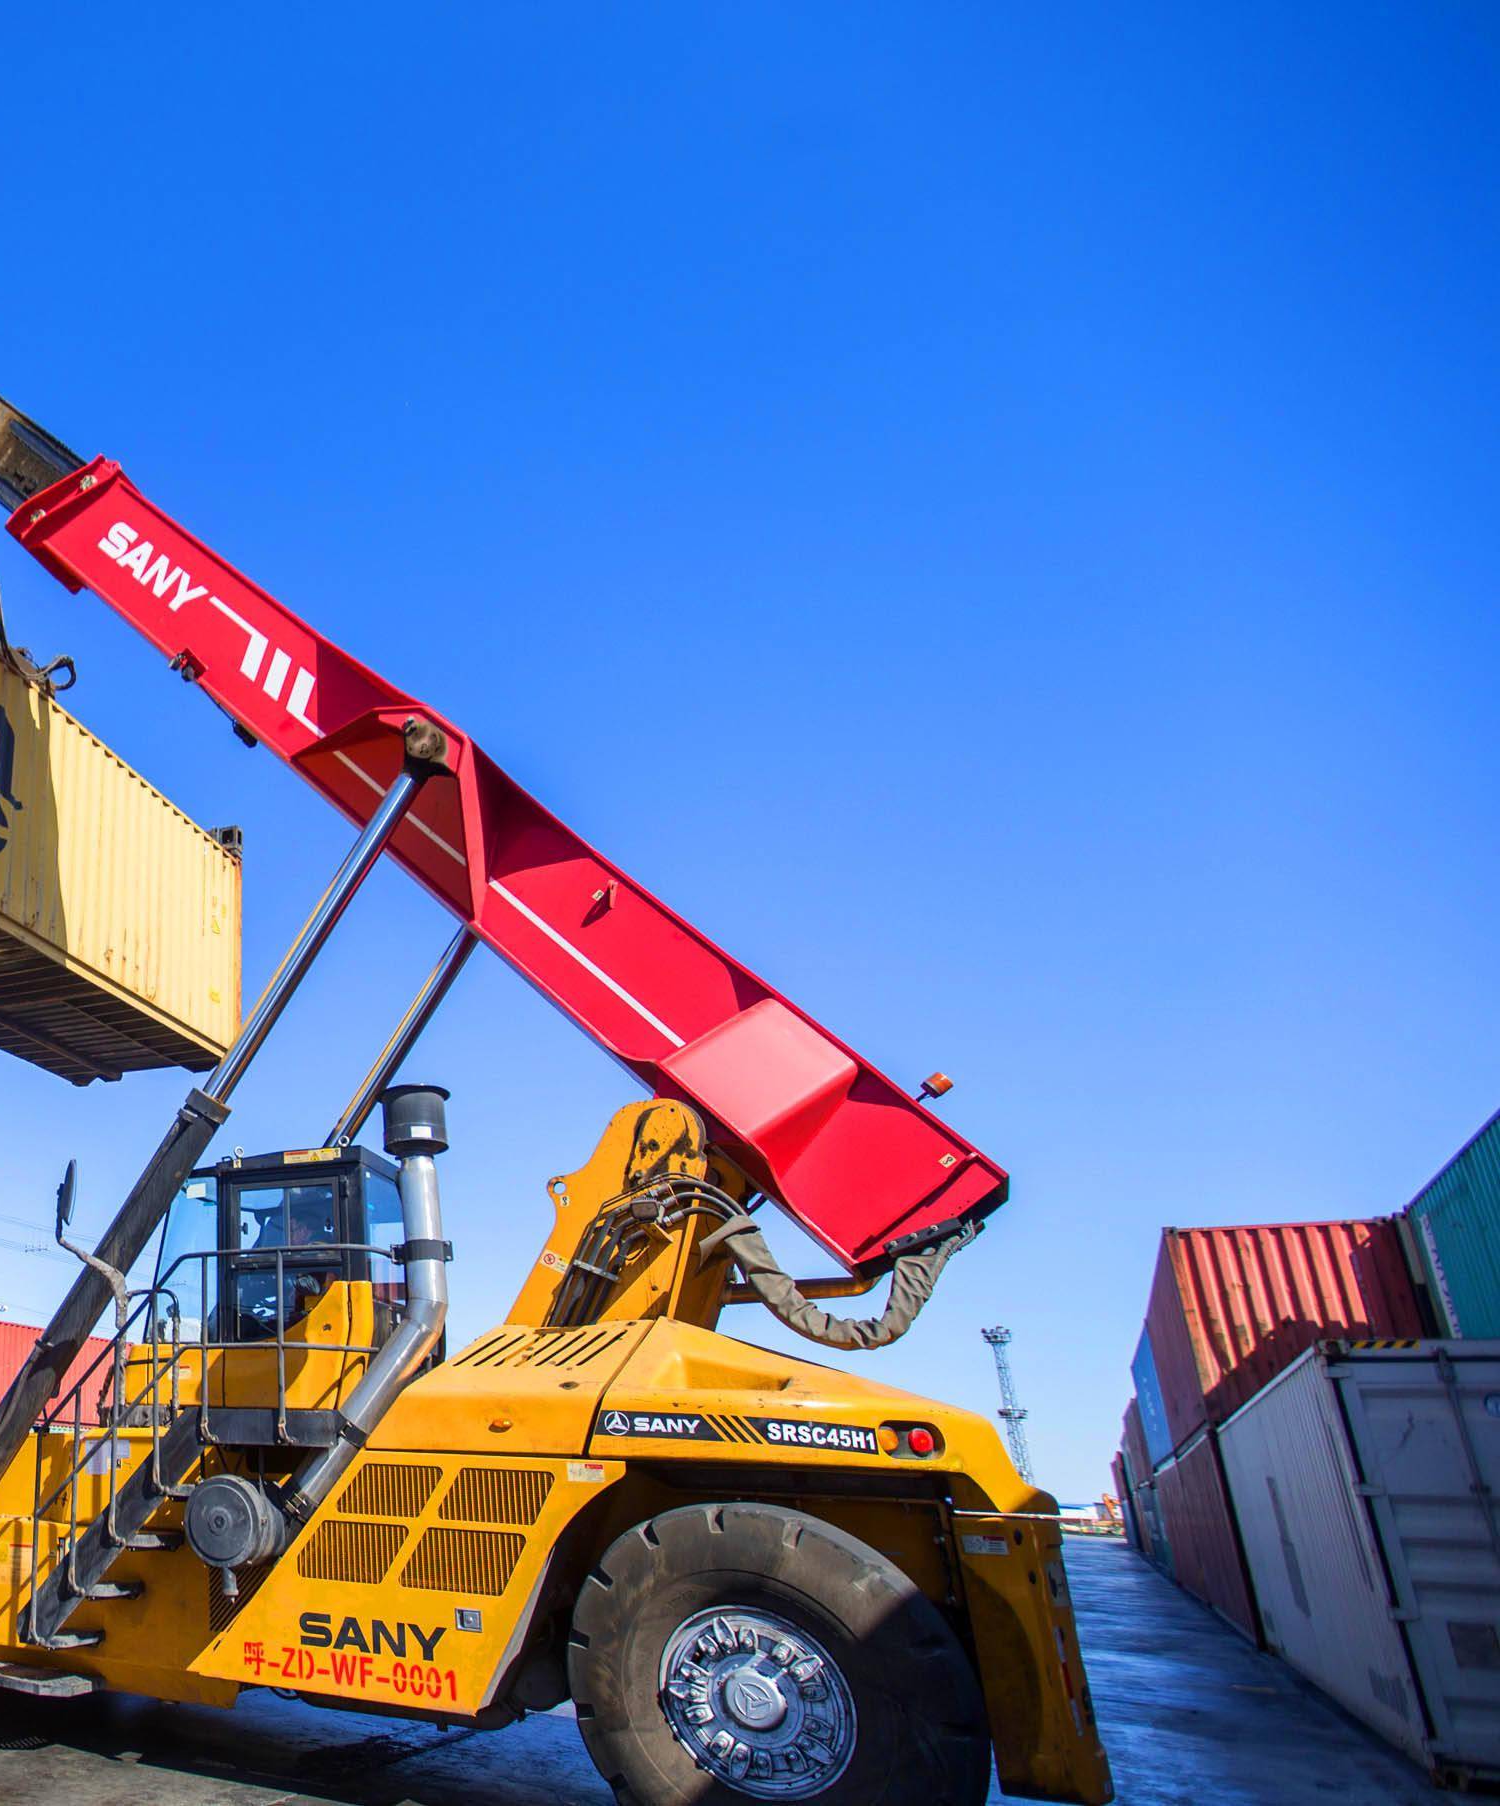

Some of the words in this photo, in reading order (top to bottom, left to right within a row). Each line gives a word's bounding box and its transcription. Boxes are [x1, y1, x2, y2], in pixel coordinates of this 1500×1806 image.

[97, 521, 209, 613] SANY
[633, 1417, 700, 1434] SANY
[767, 1423, 877, 1450] SRSC45H1
[299, 1612, 448, 1661] SANY
